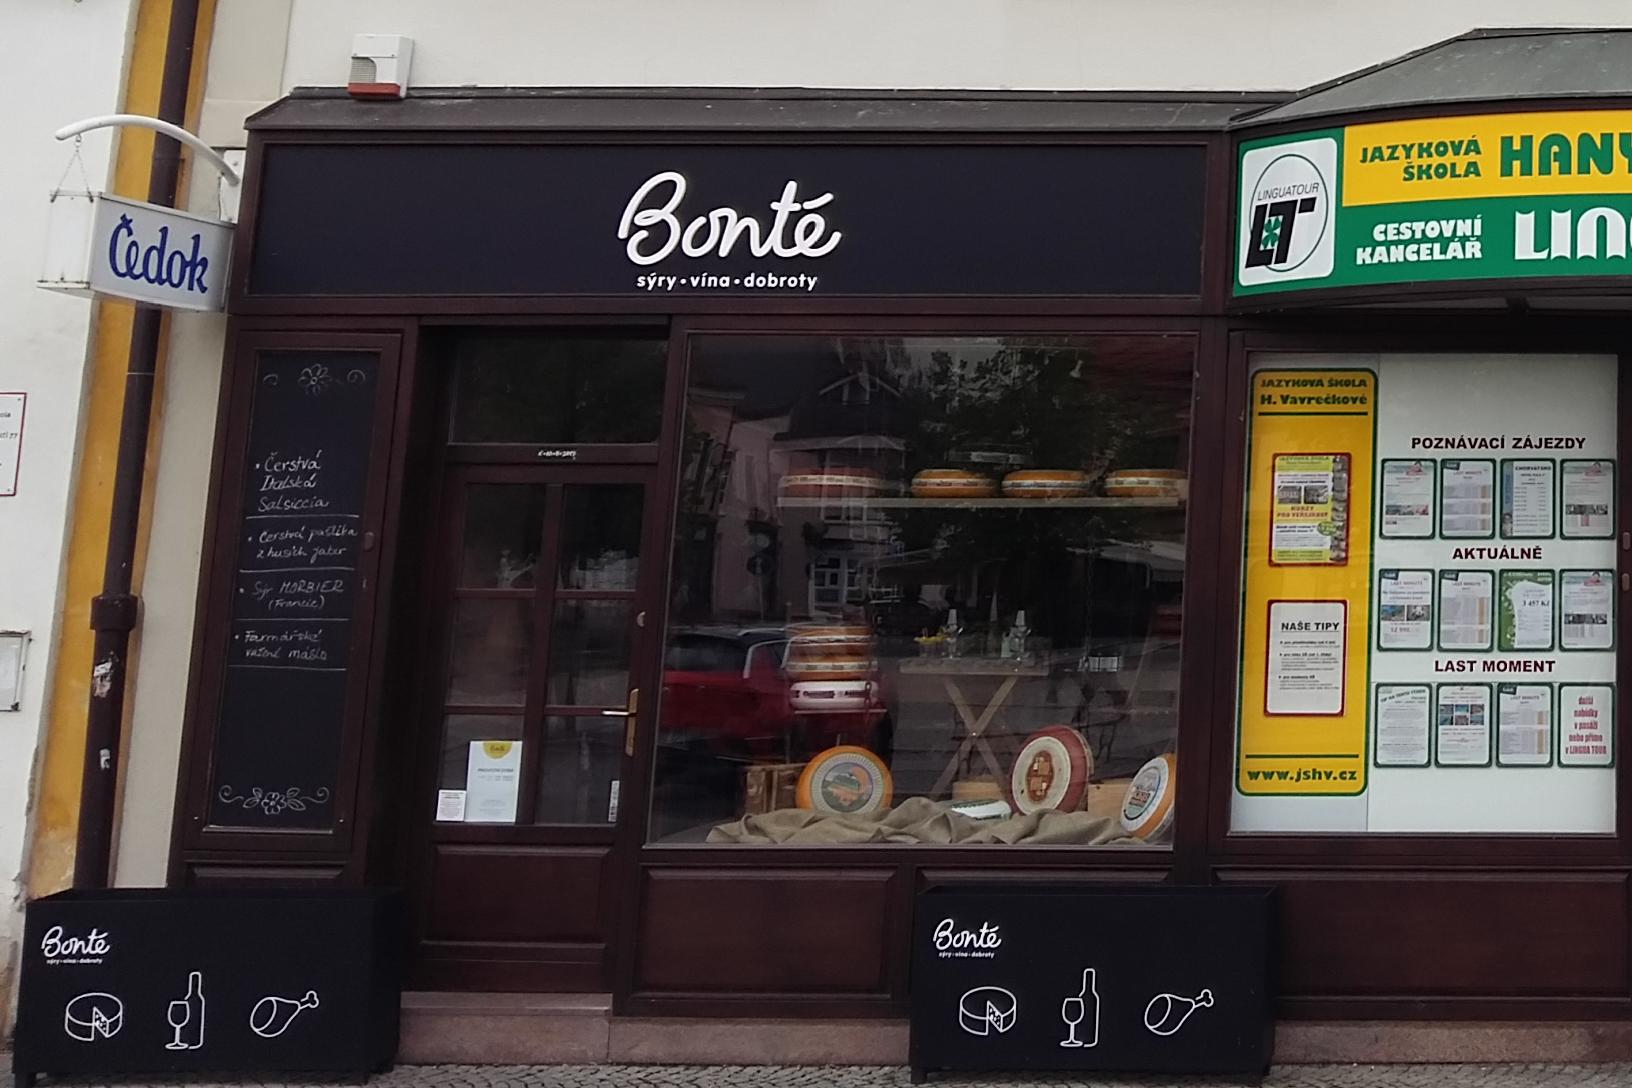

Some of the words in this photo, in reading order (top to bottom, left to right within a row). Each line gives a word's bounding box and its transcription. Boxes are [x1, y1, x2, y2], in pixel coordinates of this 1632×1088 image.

[1360, 135, 1482, 163] JAZYKOVÁ
[1402, 160, 1482, 182] ŠKOLA
[1257, 182, 1319, 201] LINGUATOUR
[617, 171, 842, 265] Bonté
[1372, 214, 1482, 242] CESTOVNÍ
[109, 213, 209, 294] Čedok
[1355, 238, 1482, 265] KANCELÁŘ
[637, 272, 676, 291] sýry
[690, 272, 730, 288] vína
[744, 272, 818, 291] dobroty
[1260, 394, 1277, 405] H.
[1280, 393, 1368, 405] Vavrečkové
[1411, 435, 1505, 449] POZNÁVACÍ
[1512, 435, 1586, 449] ZÁJEZDY
[264, 449, 322, 472] Čerstvá
[1452, 545, 1542, 560] AKTUÁLNĚ
[1281, 620, 1311, 631] NAŠE
[1314, 622, 1340, 631] TIPY
[1434, 660, 1477, 673] LAST
[1482, 660, 1556, 673] MOMENT
[1247, 768, 1358, 783] www.jshv.cz
[41, 925, 111, 958] Bonté
[933, 918, 1002, 950] Bonté
